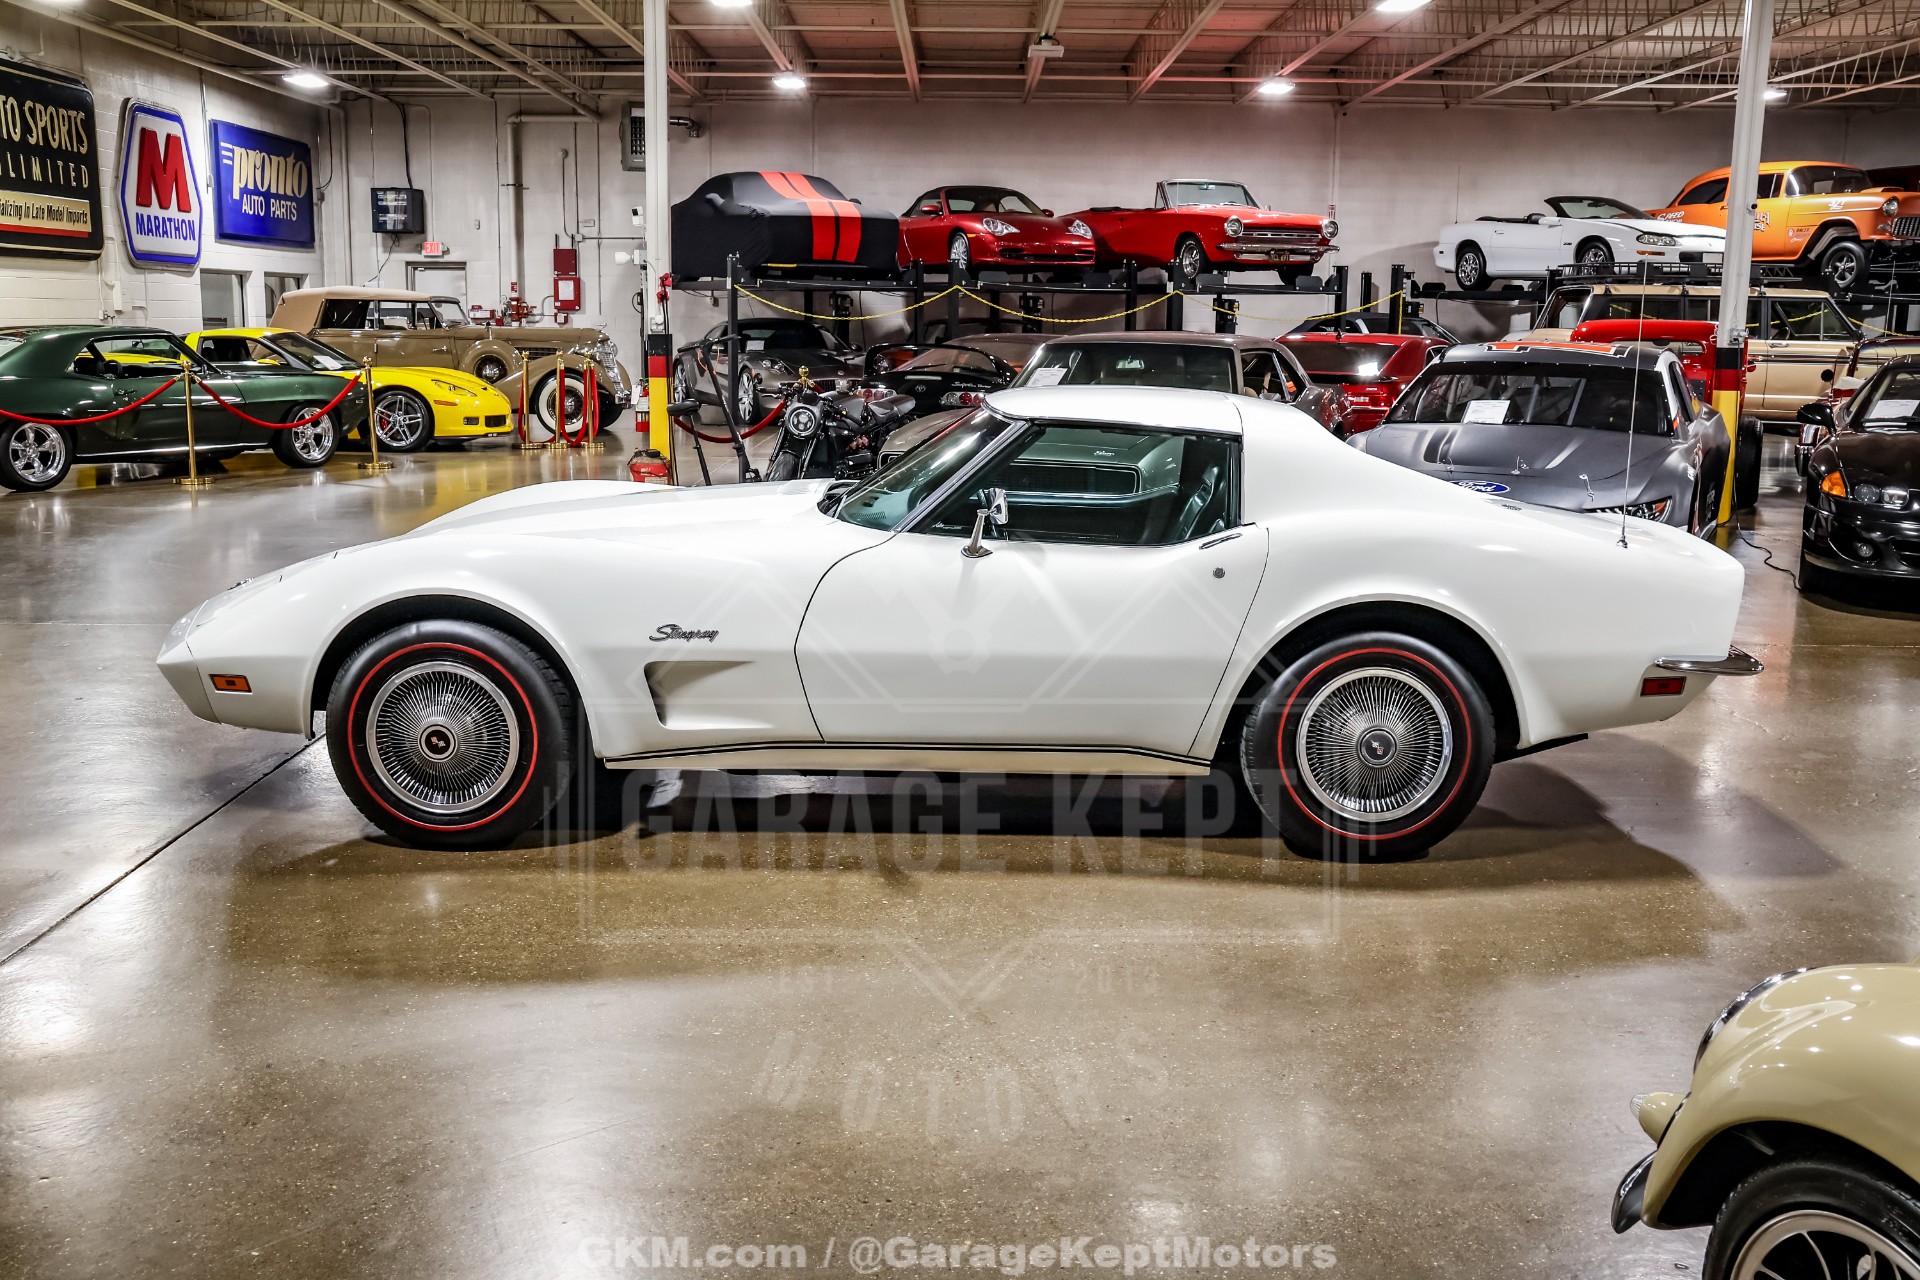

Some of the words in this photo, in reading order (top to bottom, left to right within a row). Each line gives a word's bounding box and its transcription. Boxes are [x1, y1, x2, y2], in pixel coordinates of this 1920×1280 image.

[24, 100, 88, 155] SPORTS
[0, 151, 89, 188] LIMITED
[136, 127, 192, 213] M
[232, 146, 308, 199] pronto
[24, 201, 31, 219] In
[32, 202, 45, 220] Late
[47, 204, 65, 222] Model
[65, 206, 88, 226] Imports
[241, 193, 265, 217] AUTO
[270, 198, 297, 221] PARTS
[135, 212, 196, 241] MARATHON
[424, 242, 440, 254] EXIT
[649, 623, 719, 643] Stingray
